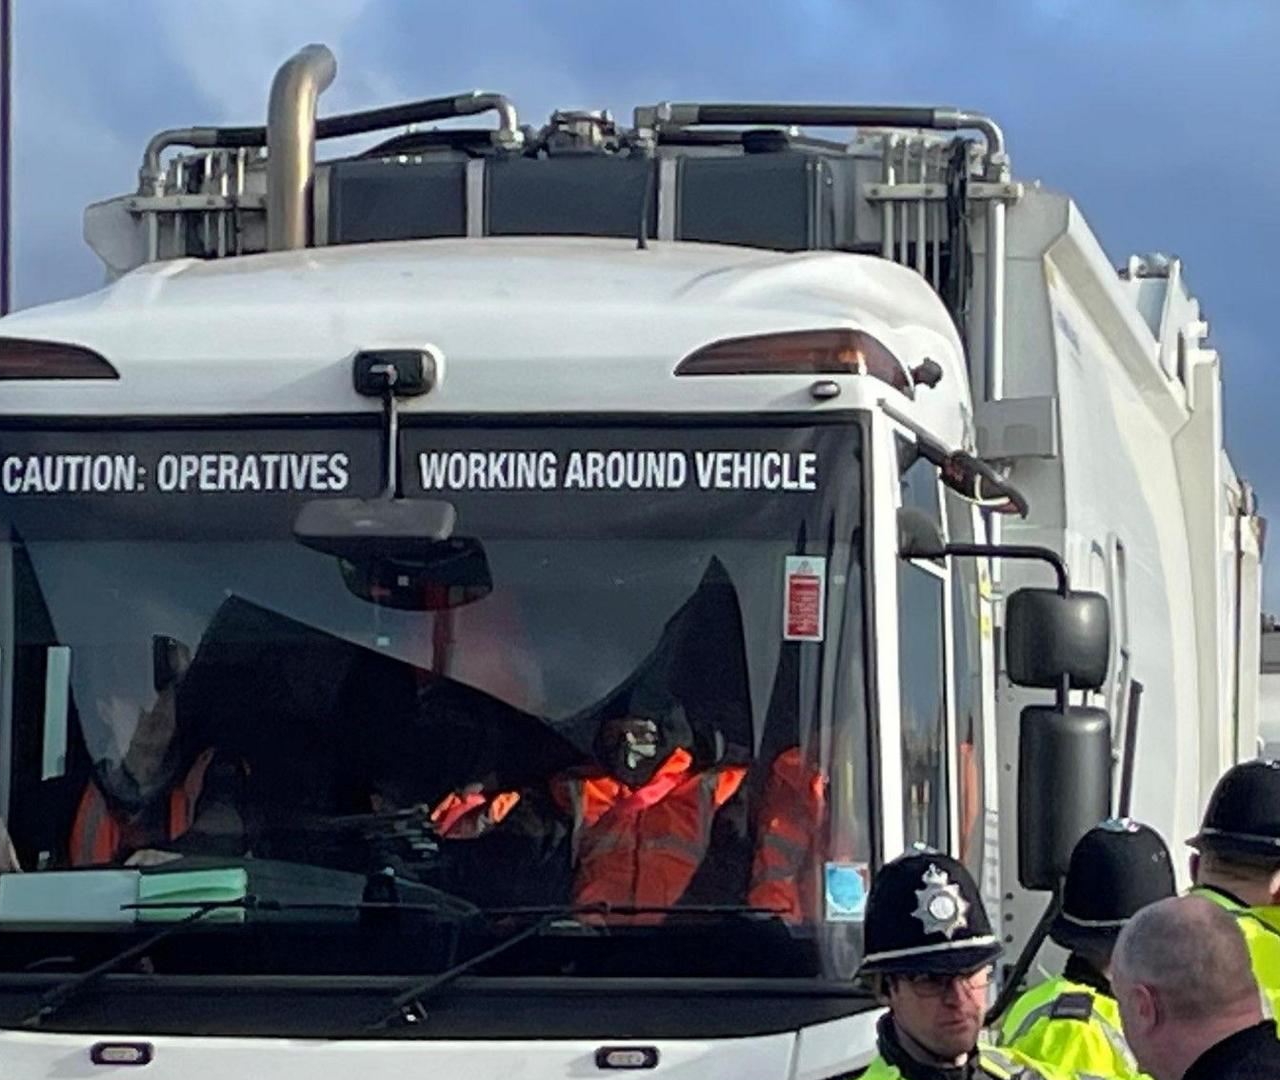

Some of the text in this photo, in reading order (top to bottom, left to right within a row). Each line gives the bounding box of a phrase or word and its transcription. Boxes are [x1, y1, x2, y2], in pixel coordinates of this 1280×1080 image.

[2, 451, 818, 494] CAUTION: OPERATIVES WORKING AROUND VEHICLE
